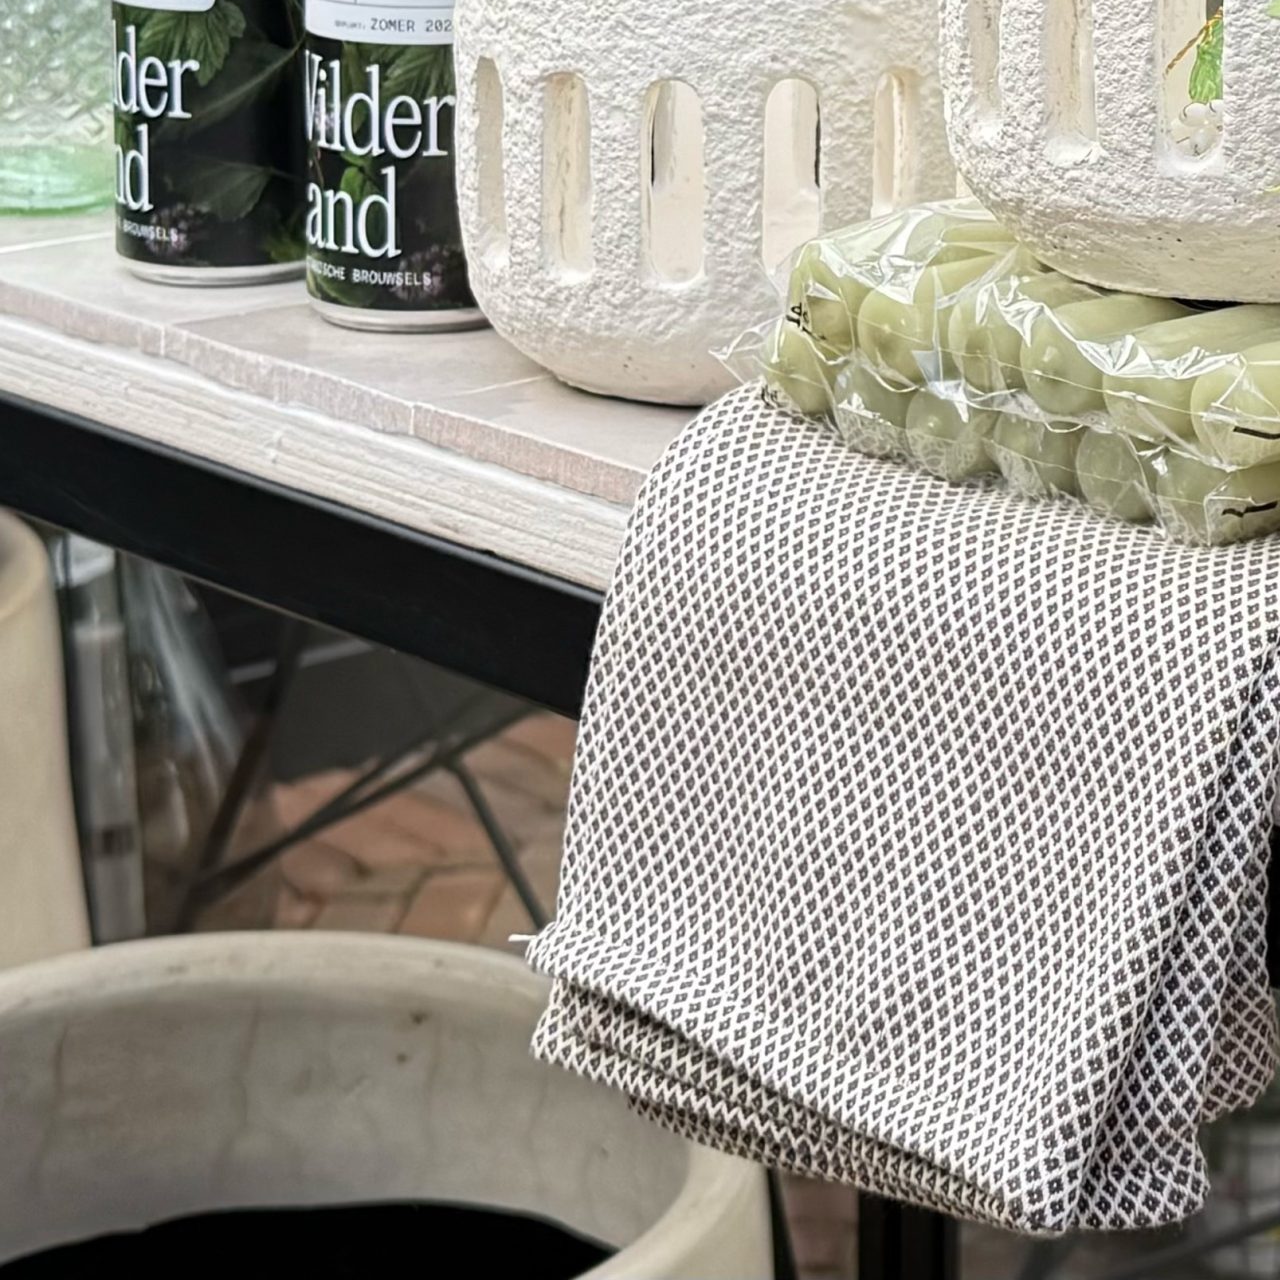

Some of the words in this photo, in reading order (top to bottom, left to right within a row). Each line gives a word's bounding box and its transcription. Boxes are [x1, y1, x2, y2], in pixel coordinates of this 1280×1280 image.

[370, 17, 415, 32] ZOMER
[425, 19, 455, 32] 202
[352, 267, 432, 286] BROUWSELS
